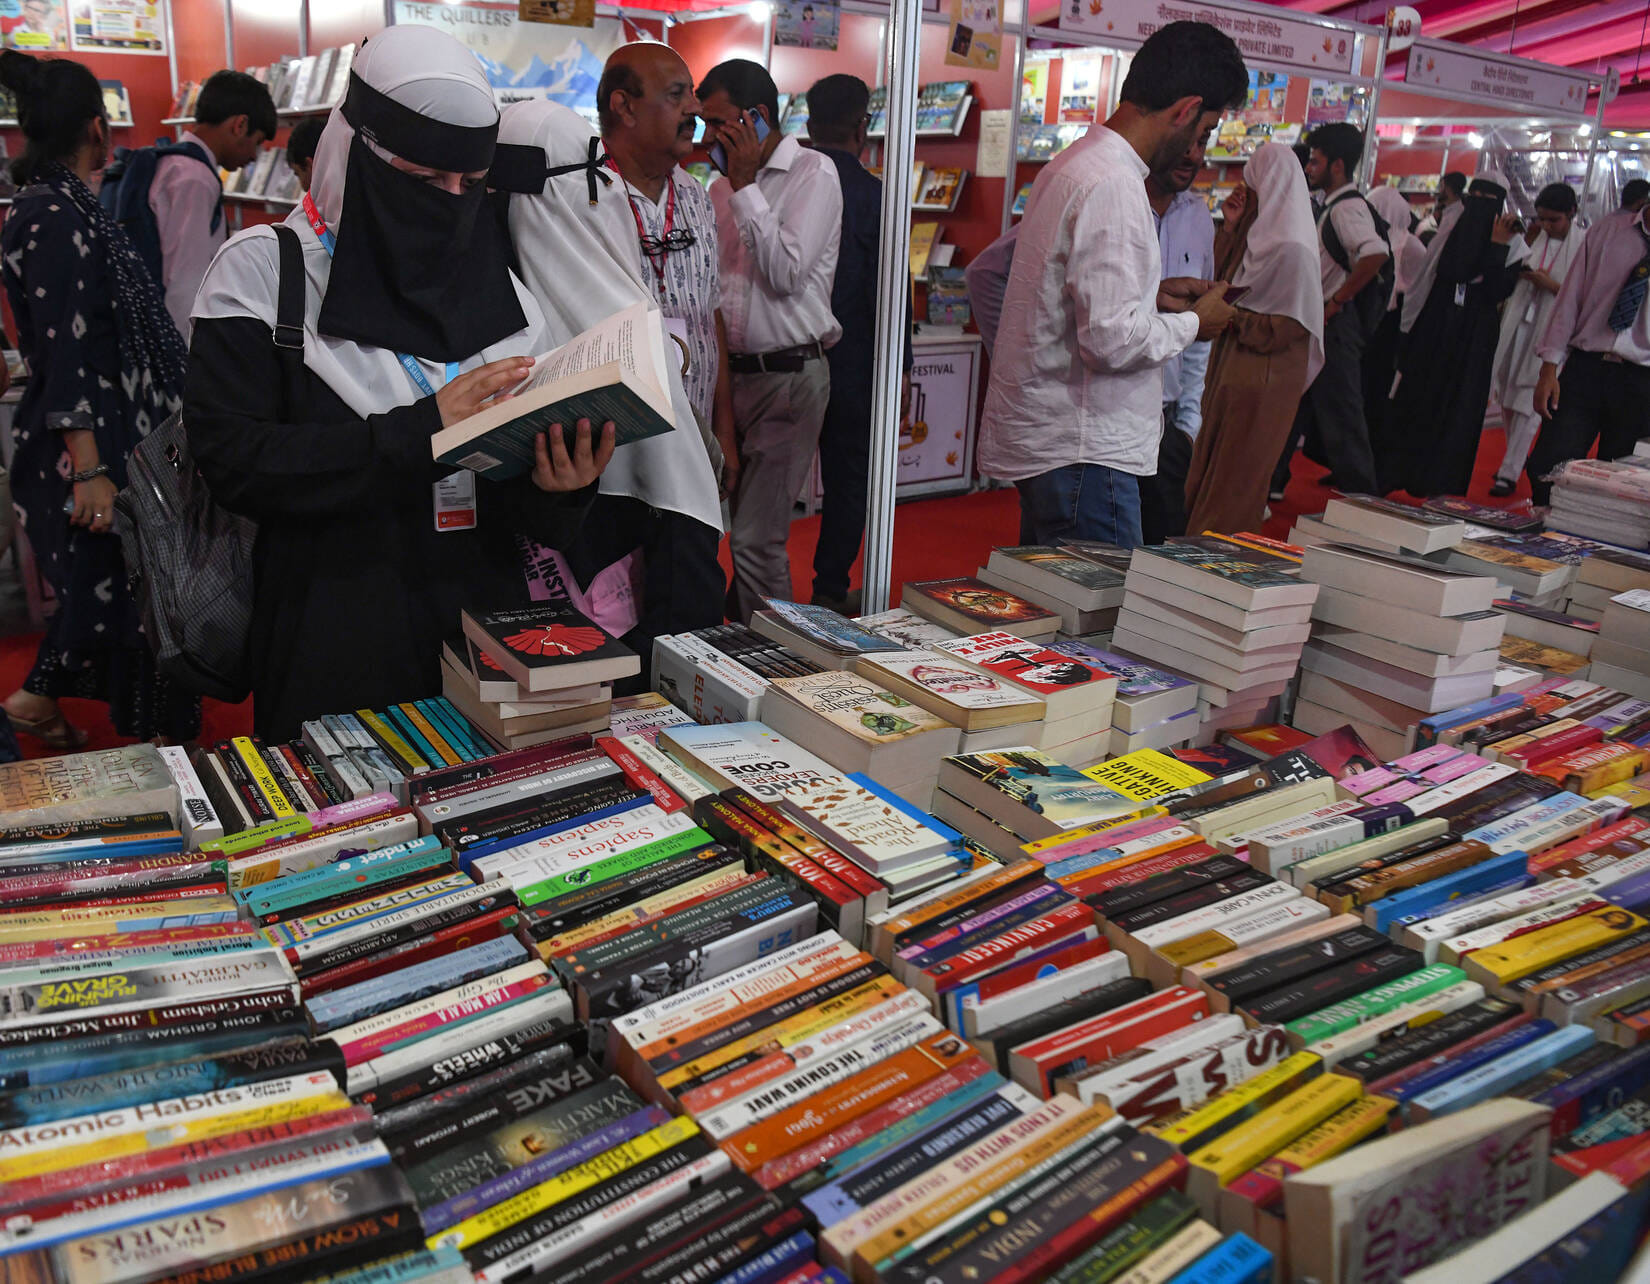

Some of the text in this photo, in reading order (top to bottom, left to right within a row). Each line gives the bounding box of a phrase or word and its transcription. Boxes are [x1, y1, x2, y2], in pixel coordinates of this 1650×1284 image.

[405, 4, 434, 22] THE
[1240, 38, 1294, 58] PRIVATE LIMITED
[911, 363, 955, 376] FESTIVAL
[611, 709, 673, 725] ADULTHO
[625, 716, 685, 732] IN EARLY
[551, 764, 595, 784] DISCOVERY
[597, 761, 613, 771] THE
[720, 759, 789, 776] CODE
[516, 780, 540, 791] INDIA
[741, 770, 820, 787] LEADERS
[1091, 767, 1161, 801] EGATIVE
[1112, 760, 1180, 794] HINKING
[259, 771, 288, 811] DEEP WORK
[617, 793, 637, 802] KEEP
[189, 799, 210, 826] NOISE
[25, 826, 79, 838] BALLAD
[538, 817, 625, 849] Sapiens
[846, 815, 905, 838] Ahead
[864, 824, 917, 845] Road
[224, 835, 248, 844] words
[567, 826, 654, 861] Sapiens
[138, 851, 207, 870] GANDHI
[359, 837, 426, 865] mindset
[722, 885, 752, 901] SEARCH
[752, 876, 776, 890] MAN'S
[368, 880, 507, 930] INDOMITABLE SPIRIT
[703, 896, 721, 908] FOR
[713, 906, 730, 918] FOR
[731, 894, 762, 910] SEARCH
[662, 907, 702, 926] MEANING
[671, 916, 711, 935] MEANING
[171, 940, 253, 957] Moral Ambition
[320, 947, 353, 964] KALAM
[777, 947, 797, 961] WITH
[40, 964, 81, 976] Bregman
[746, 954, 778, 972] CANCER
[152, 961, 267, 986] GALBRAITH
[710, 970, 736, 987] EARLY
[829, 966, 873, 991] FREEDOM
[39, 974, 128, 996] GRAVE
[37, 984, 137, 1008] RUNNING
[244, 993, 287, 1010] John
[483, 988, 502, 1005] AM
[661, 984, 710, 1010] ADULTHOOD
[796, 990, 817, 1006] NOT
[162, 999, 240, 1020] Grisham
[436, 994, 482, 1023] MALALA
[771, 1000, 795, 1016] FREE
[105, 1013, 141, 1030] Jim
[147, 1013, 263, 1041] JOHN GRISHAM
[433, 1042, 502, 1078] WHEELS
[839, 1049, 865, 1068] THE
[116, 1075, 148, 1090] THE
[247, 1079, 292, 1093] James
[506, 1065, 593, 1112] FAKE
[784, 1063, 839, 1095] COMING
[30, 1082, 105, 1105] WATER
[252, 1086, 292, 1099] Clear
[743, 1088, 786, 1114] WAVE
[0, 1115, 127, 1147] Atomic
[135, 1087, 244, 1123] Habits
[539, 1089, 634, 1141] MARTIN
[1047, 1101, 1066, 1120] IT
[413, 1107, 499, 1148] ROBERT KIYOSAKI
[1013, 1111, 1049, 1139] ENDS
[921, 1117, 984, 1158] REDESIGNED
[978, 1132, 1013, 1159] WITH
[663, 1151, 689, 1170] THE
[952, 1151, 978, 1175] US
[554, 1165, 661, 1229] CONSTITUTION
[79, 1214, 227, 1260] SPARKS
[532, 1219, 554, 1235] OF
[314, 1226, 379, 1251] SLOW
[482, 1230, 531, 1260] INDIA
[978, 1218, 1044, 1262] INDIA
[262, 1240, 308, 1266] FIRE
